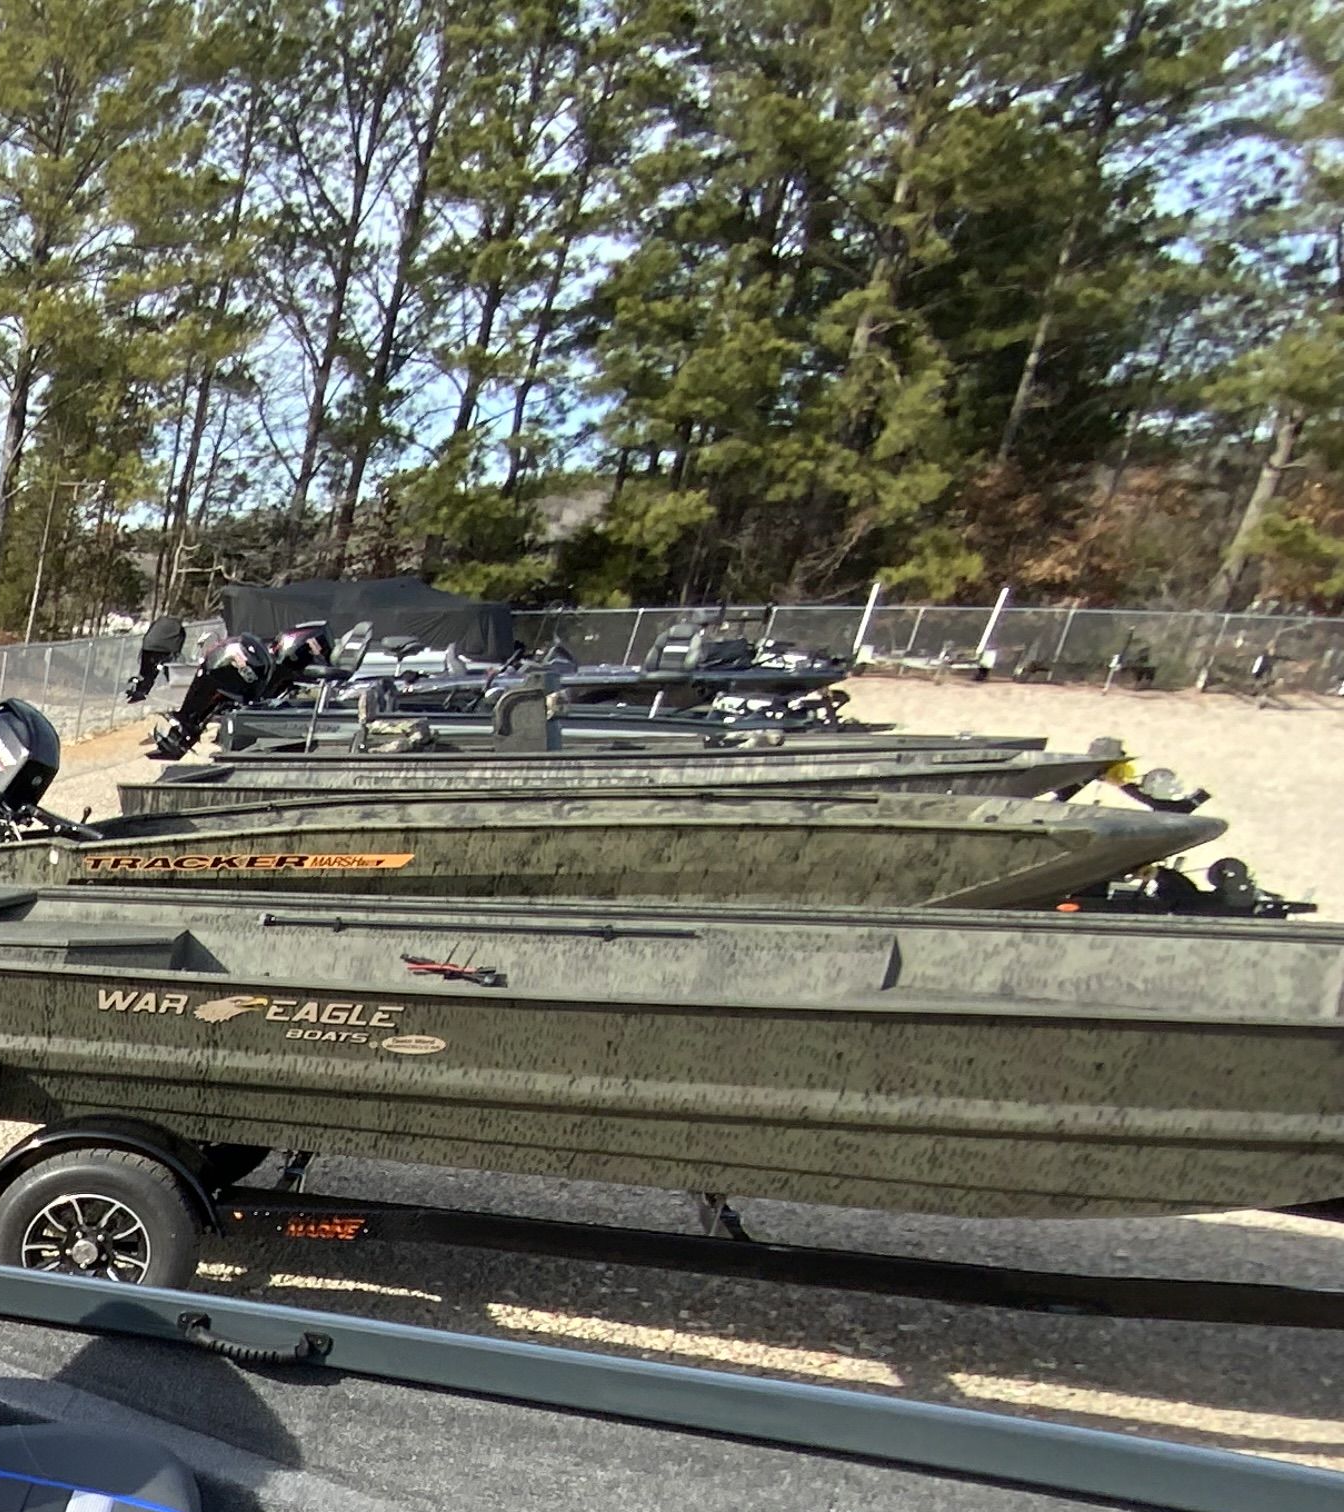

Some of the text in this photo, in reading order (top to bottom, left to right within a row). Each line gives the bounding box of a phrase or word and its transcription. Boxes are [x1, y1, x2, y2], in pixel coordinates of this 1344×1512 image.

[84, 854, 310, 872] TRACKER
[98, 989, 405, 1028] WAR EAGLE
[285, 1028, 369, 1044] BOATS
